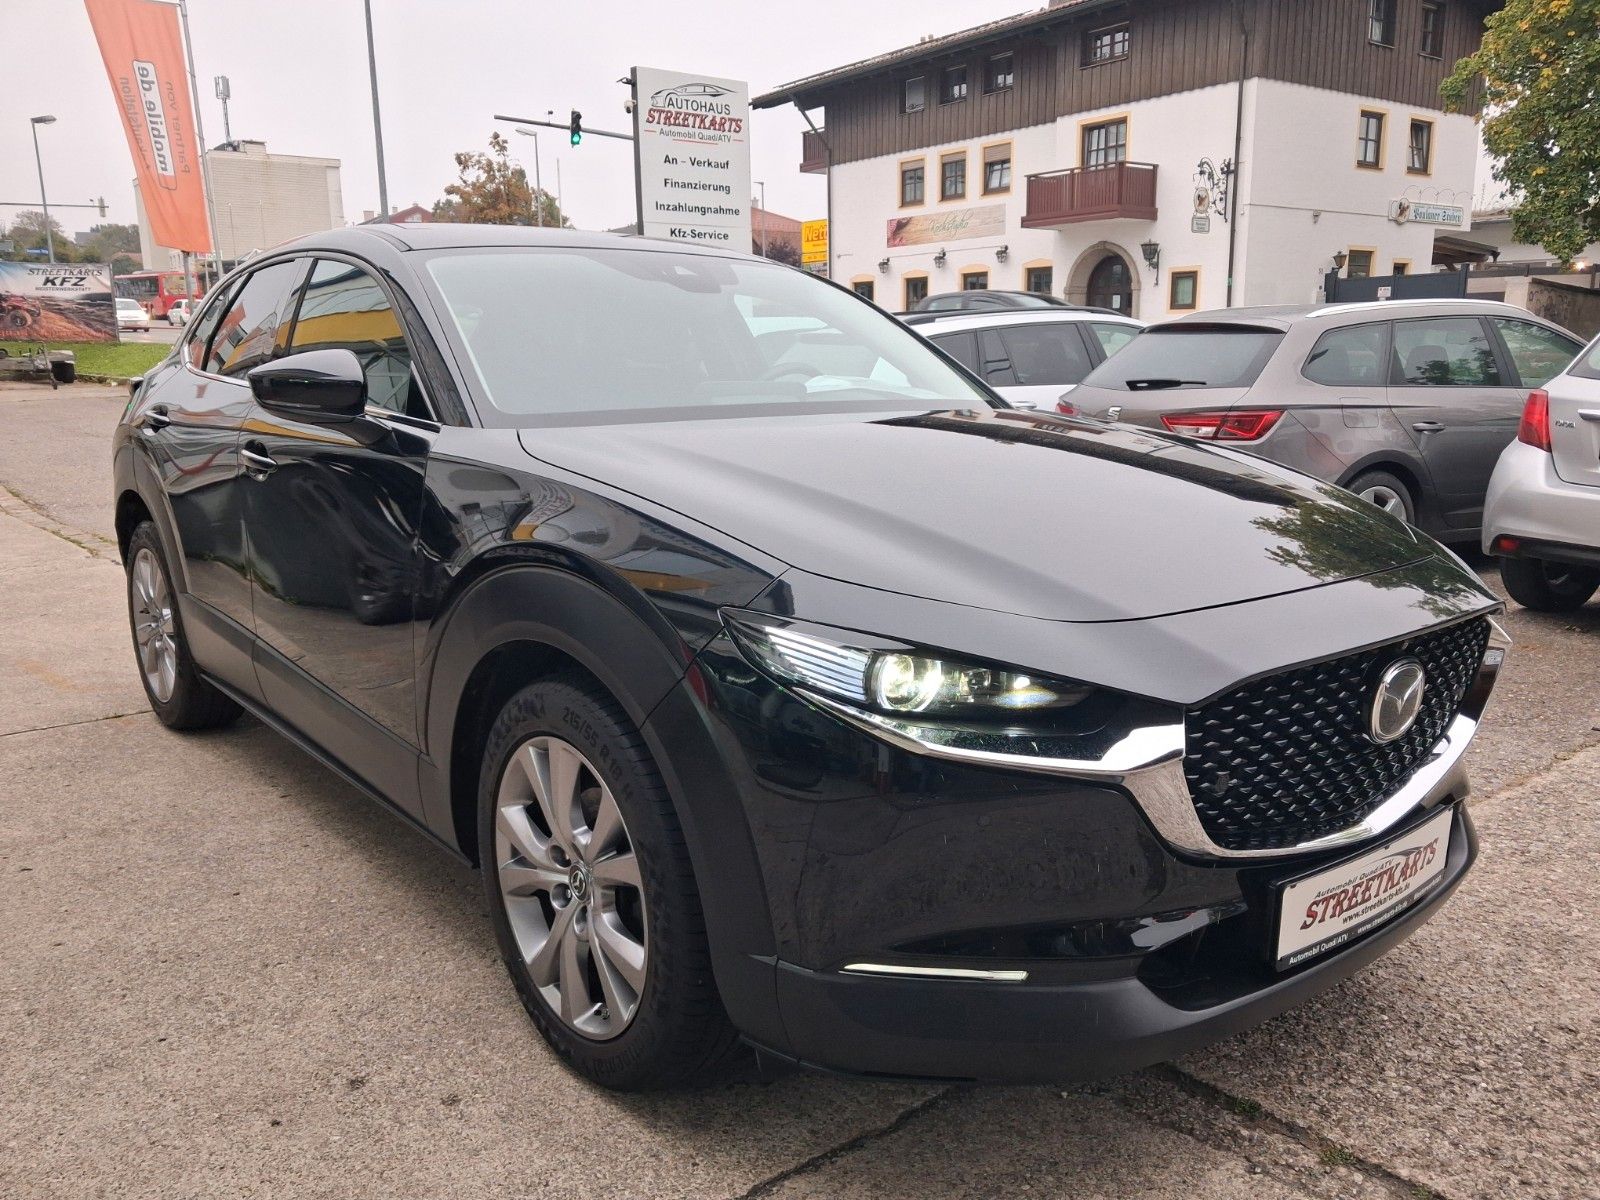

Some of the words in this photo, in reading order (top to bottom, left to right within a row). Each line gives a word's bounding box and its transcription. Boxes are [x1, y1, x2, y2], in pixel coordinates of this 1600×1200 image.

[667, 98, 731, 115] AUTOHAUS
[646, 109, 743, 133] STREETKARTS
[659, 128, 696, 140] Automobil
[664, 154, 678, 165] An
[689, 157, 729, 170] Verkauf
[664, 178, 731, 194] Finanzierung
[655, 201, 740, 216] Inzahlungnahme
[670, 228, 729, 241] Kfz-Service
[803, 225, 828, 243] Nett
[27, 268, 103, 277] STREETKARTS
[42, 276, 87, 287] KFZ
[561, 706, 600, 747] 215/55
[1300, 837, 1439, 930] STREETKARTS
[1315, 875, 1358, 898] Automobil
[1289, 945, 1320, 965] Automobil
